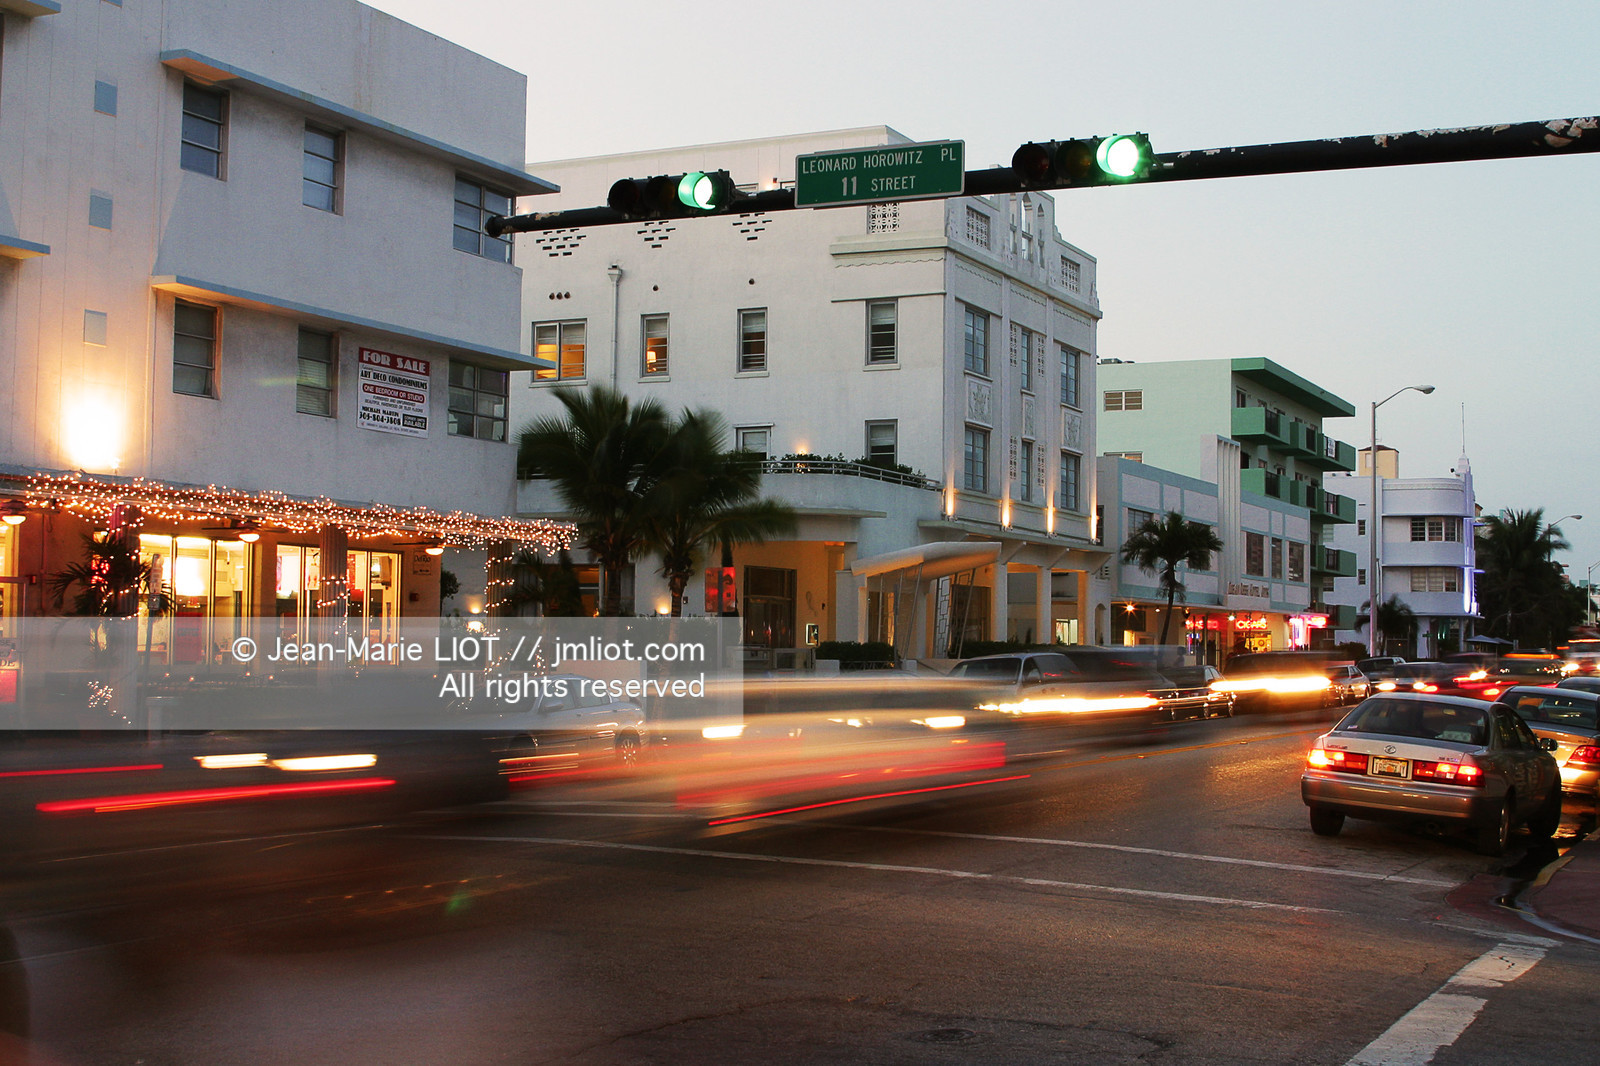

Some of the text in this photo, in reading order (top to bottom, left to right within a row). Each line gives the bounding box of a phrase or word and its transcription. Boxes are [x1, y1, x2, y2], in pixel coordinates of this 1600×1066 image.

[802, 148, 956, 174] LEONARD HOROWITZ PL
[842, 176, 916, 196] 11 STREET
[363, 350, 426, 373] FOR SALE
[361, 370, 427, 389] ART DECO CONDOMINIUMS
[376, 387, 398, 396] BEDROOM
[407, 393, 423, 402] STUDIO
[1236, 620, 1267, 629] CIGARS
